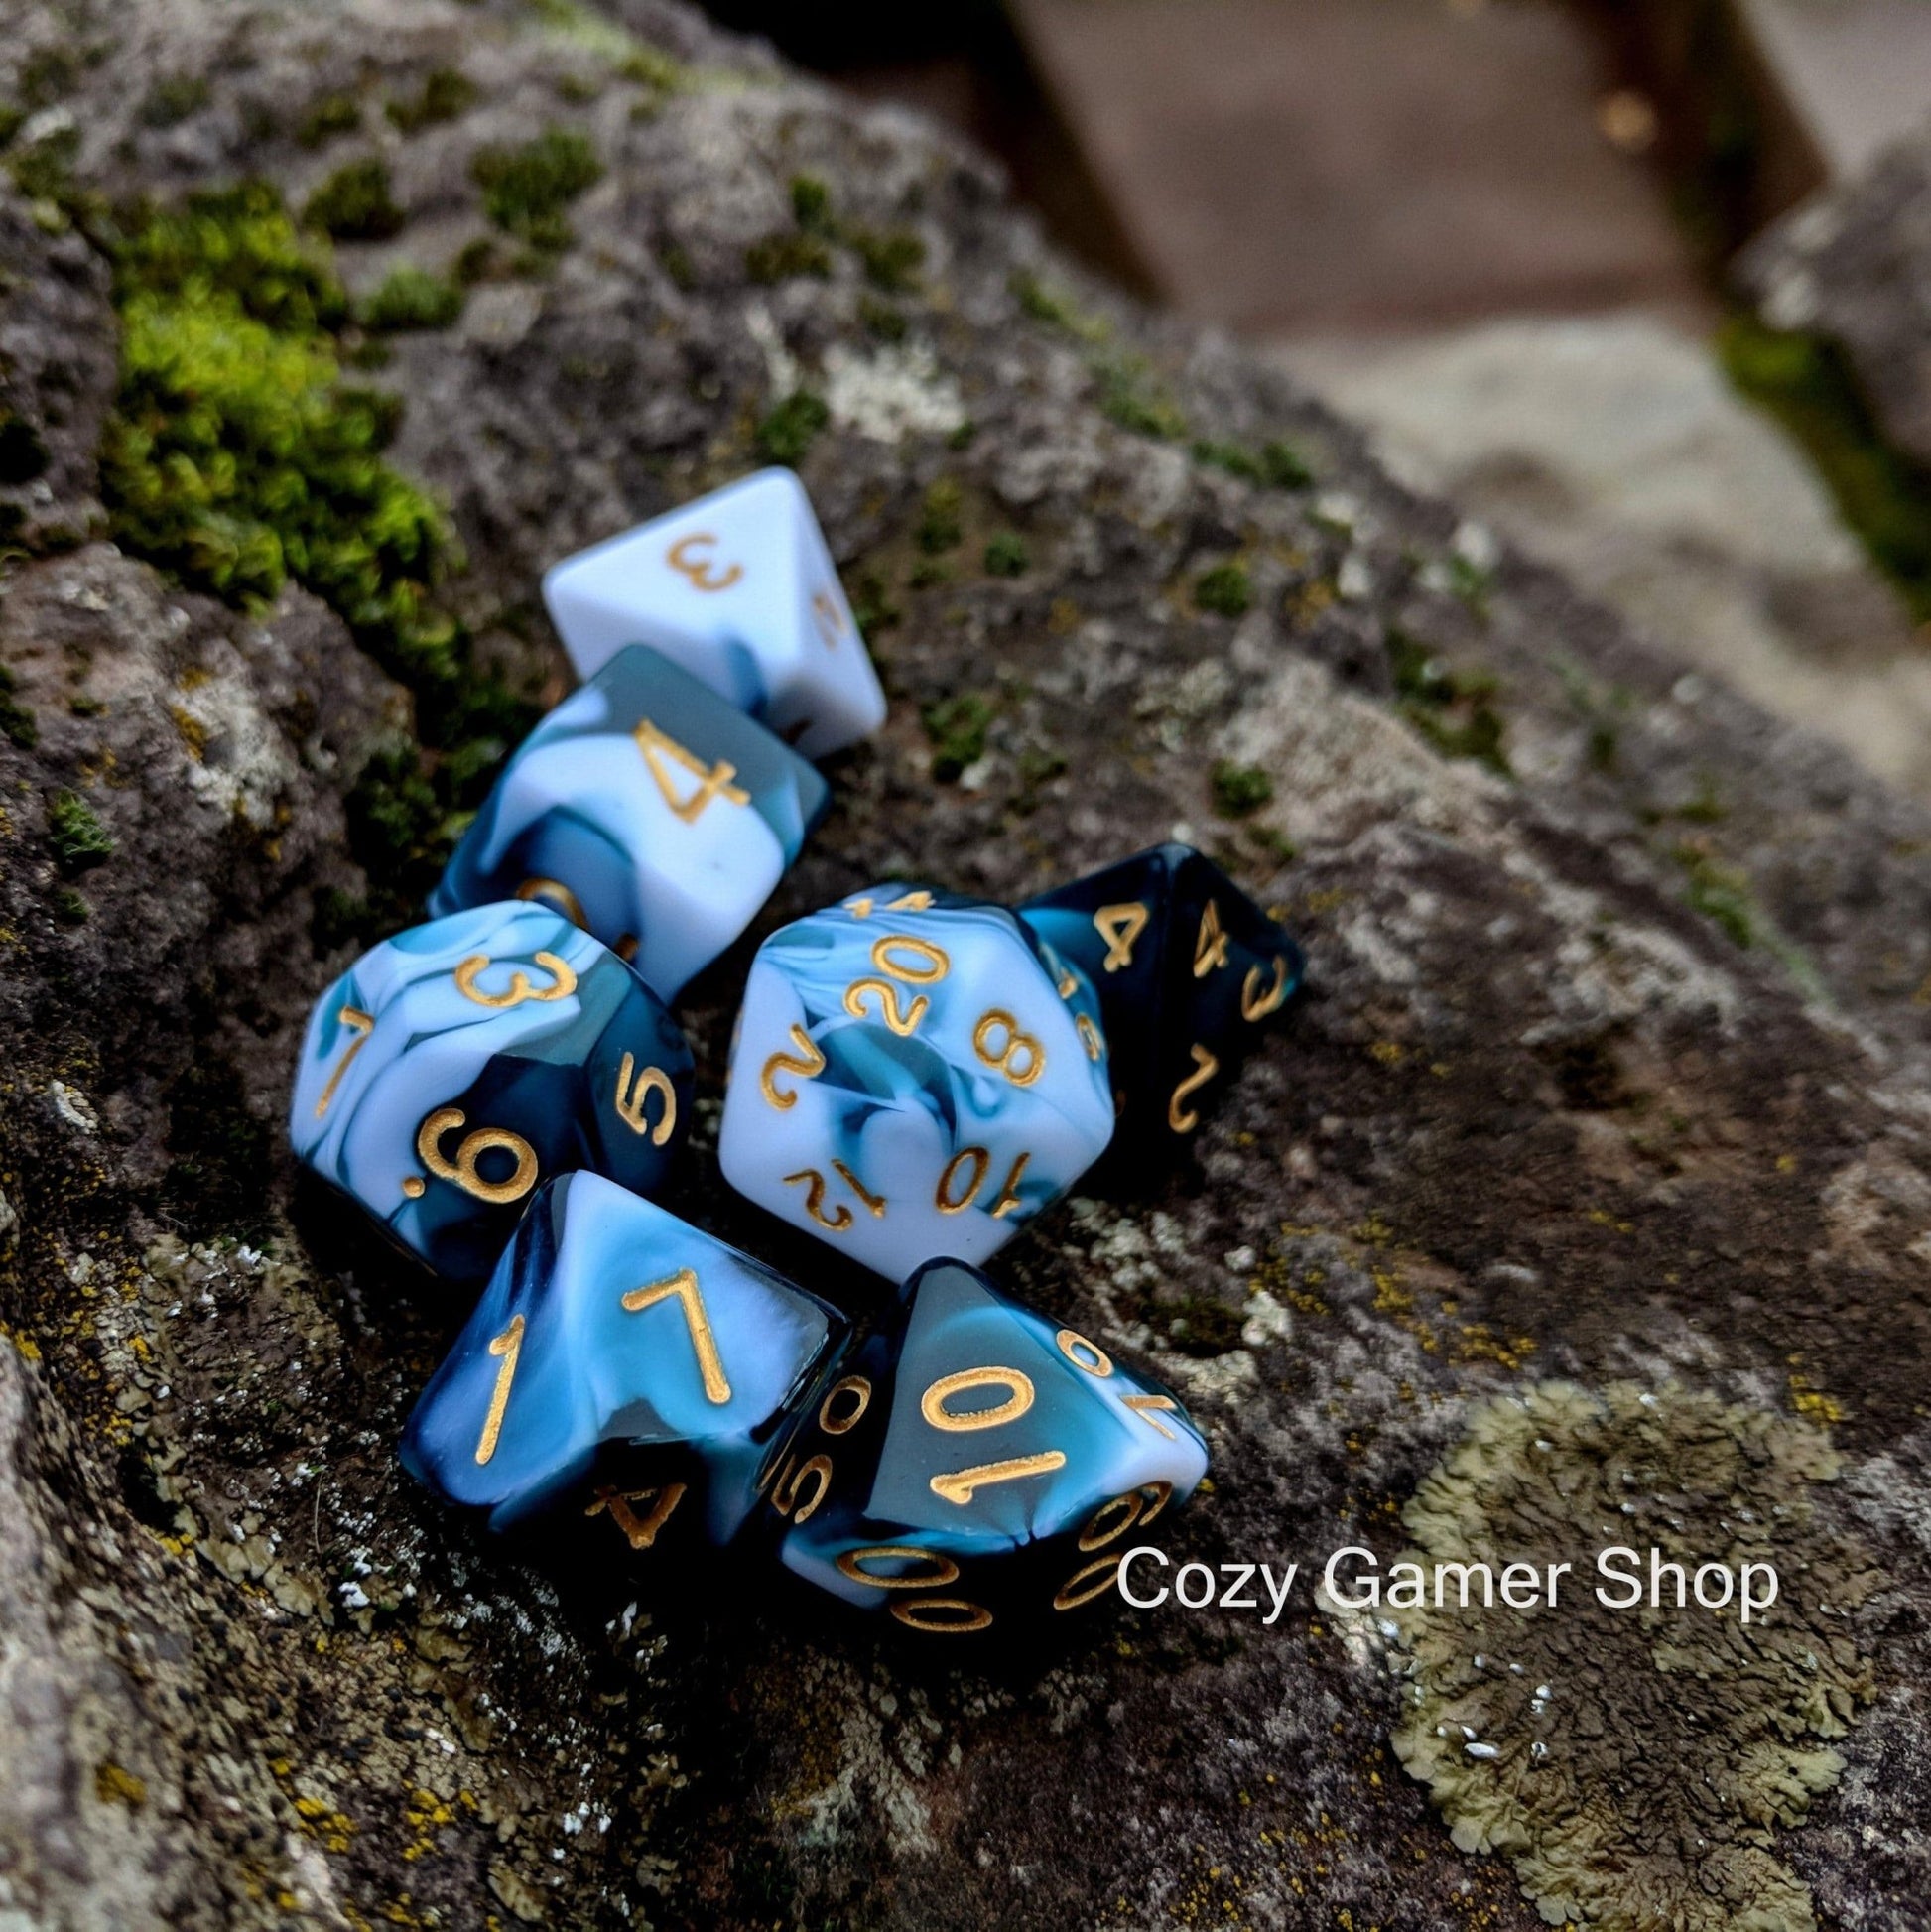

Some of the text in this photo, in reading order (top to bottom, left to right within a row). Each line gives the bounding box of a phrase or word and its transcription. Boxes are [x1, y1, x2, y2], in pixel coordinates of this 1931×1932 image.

[667, 531, 744, 592] 3
[632, 717, 751, 824] 4
[454, 951, 578, 1008] 3
[1093, 902, 1150, 973] 4
[1193, 898, 1230, 978] 4
[843, 935, 951, 1037] 20
[760, 1024, 826, 1111] 2
[972, 1008, 1046, 1087] 8
[1168, 1043, 1219, 1133] 2
[615, 1051, 677, 1146] 5
[783, 1159, 887, 1231] 12
[935, 1146, 1031, 1220] 10
[621, 1268, 731, 1405] 7
[475, 1314, 525, 1465] 1
[770, 1374, 872, 1524] 50
[921, 1365, 1067, 1505] 10
[584, 1482, 688, 1551] 4
[836, 1545, 993, 1633] 00
